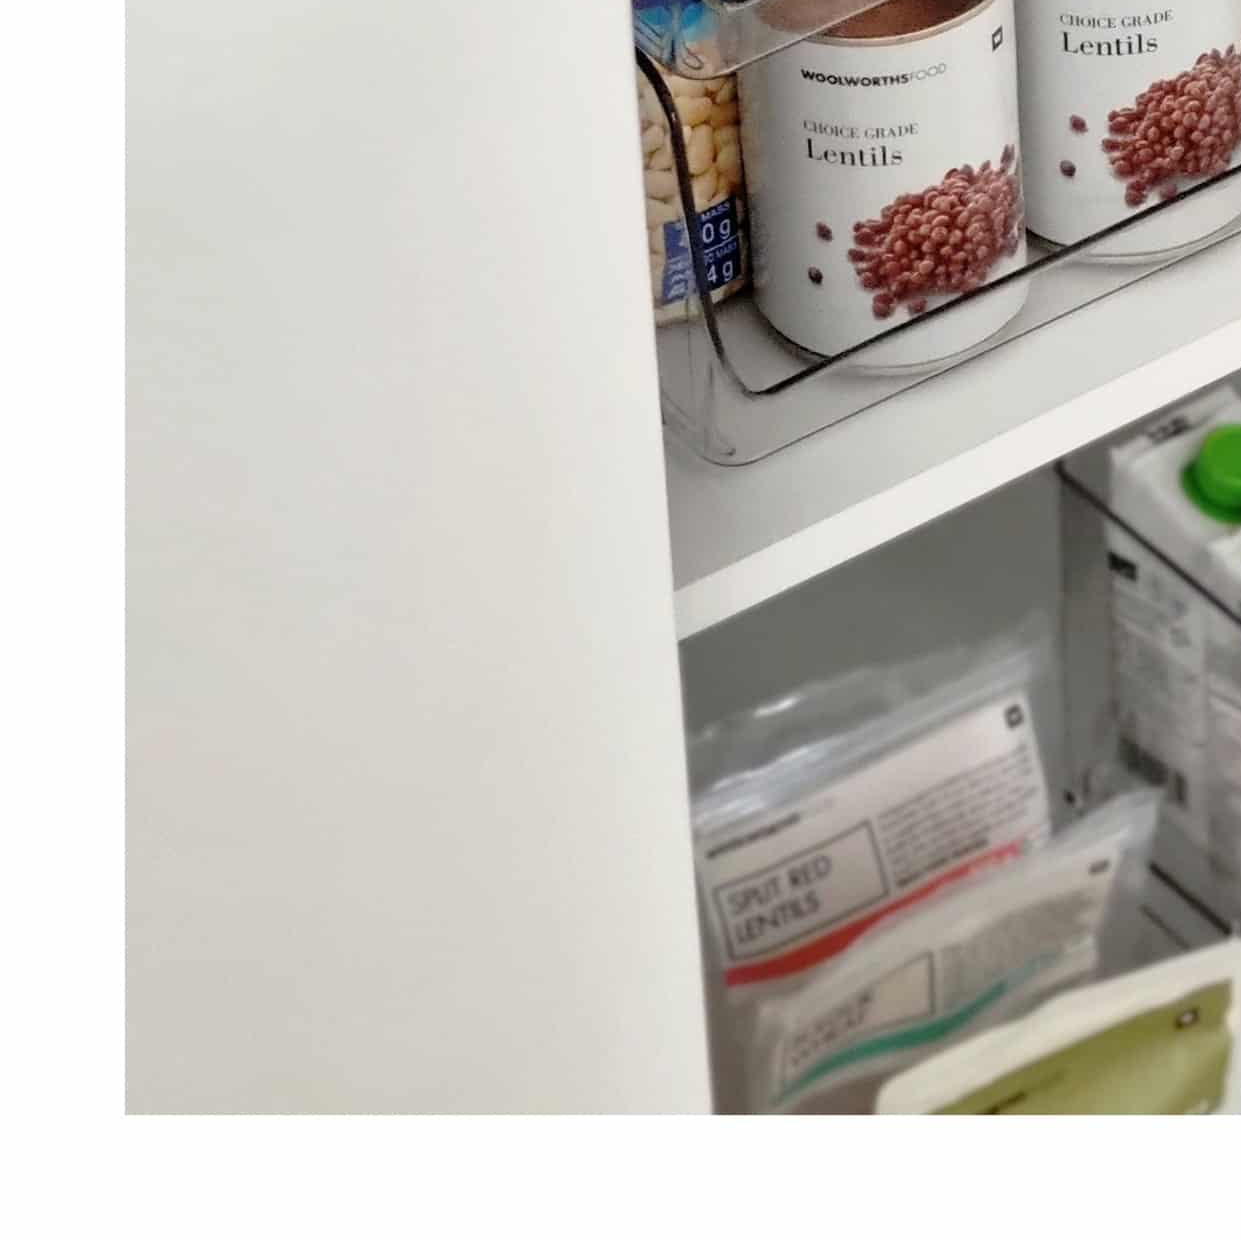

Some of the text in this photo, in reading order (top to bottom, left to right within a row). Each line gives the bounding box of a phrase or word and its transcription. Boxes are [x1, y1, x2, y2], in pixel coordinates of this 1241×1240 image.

[1060, 10, 1174, 29] CHOICE GRADE
[1062, 31, 1158, 57] Lentils
[800, 63, 947, 87] WOOLWORTHSFOOD
[803, 120, 919, 139] CHOICE GRADE
[806, 138, 903, 167] Lentils
[720, 219, 730, 239] g
[723, 261, 733, 281] g
[728, 854, 832, 916] SPLIT RED
[734, 888, 820, 944] LENTILS
